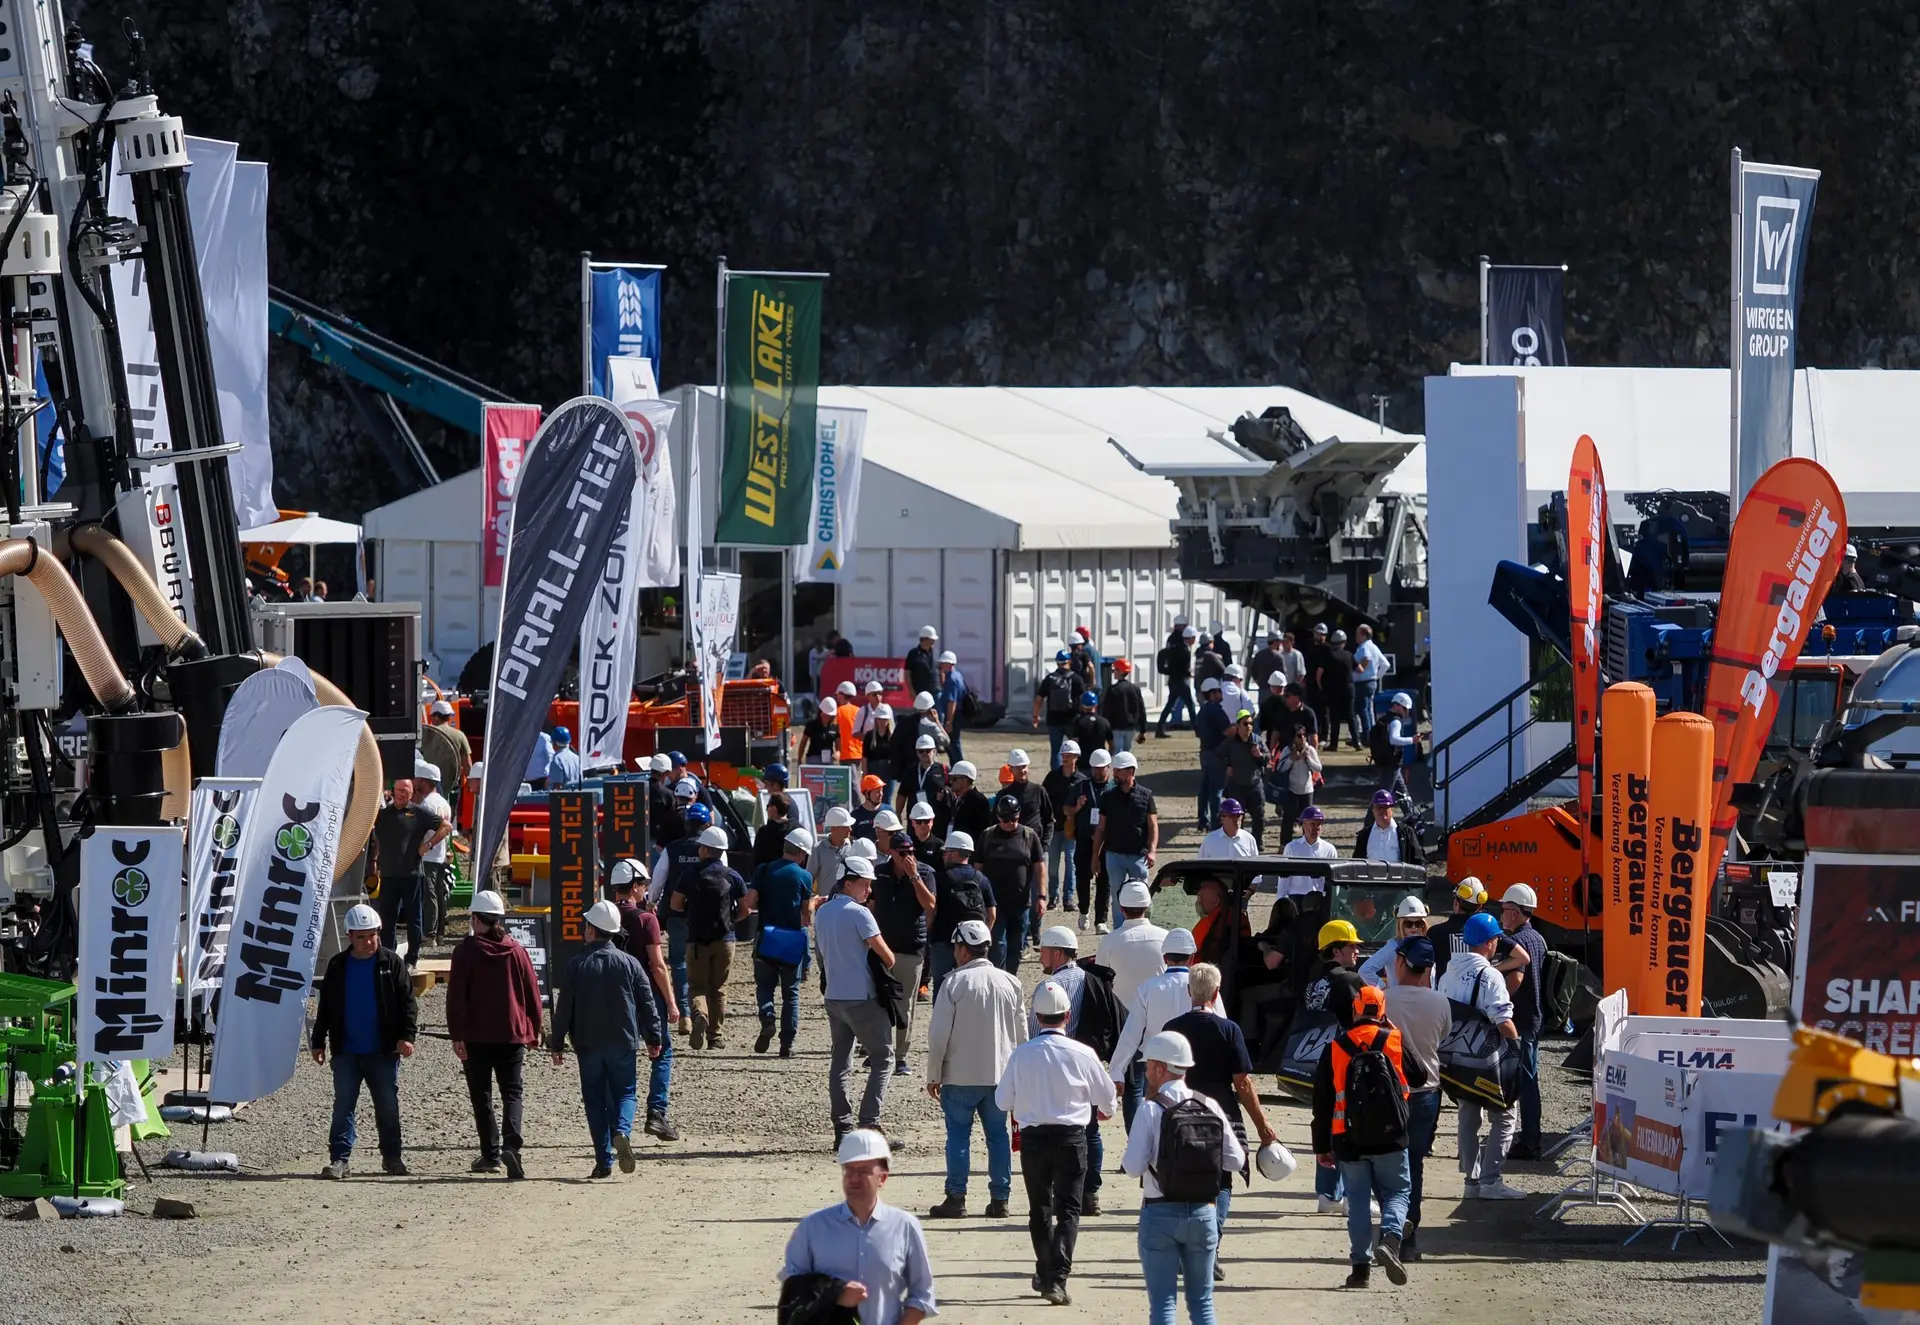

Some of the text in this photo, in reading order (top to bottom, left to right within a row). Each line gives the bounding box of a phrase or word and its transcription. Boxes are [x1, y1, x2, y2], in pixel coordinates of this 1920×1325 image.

[785, 354, 793, 381] OTR
[1746, 307, 1793, 330] WIRTGEN
[1750, 334, 1788, 357] GROUP
[744, 290, 785, 527] WEST LAKE
[818, 419, 837, 543] CHRISTOPHEL
[1786, 499, 1822, 571] Regenerierung
[498, 423, 627, 700] PRALL-TEC
[1740, 505, 1839, 718] Bergauer
[854, 664, 904, 683] KÖLSCH
[303, 805, 339, 950] Bohrausrüstungen GmbH
[561, 797, 583, 940] PRALL-TEC
[614, 786, 634, 858] L-TEC
[1487, 841, 1538, 854] HAMM
[1611, 773, 1623, 906] Verstärkung kommt.
[1623, 773, 1650, 935] Bergauer
[94, 839, 164, 1055] Minroc
[235, 792, 320, 1004] Minroc
[1649, 816, 1665, 971] Verstärkung kommt.
[1663, 816, 1702, 1012] Bergauer
[1293, 1023, 1339, 1060] CA
[1606, 1066, 1626, 1087] ELMA
[1658, 1050, 1735, 1069] ELMA
